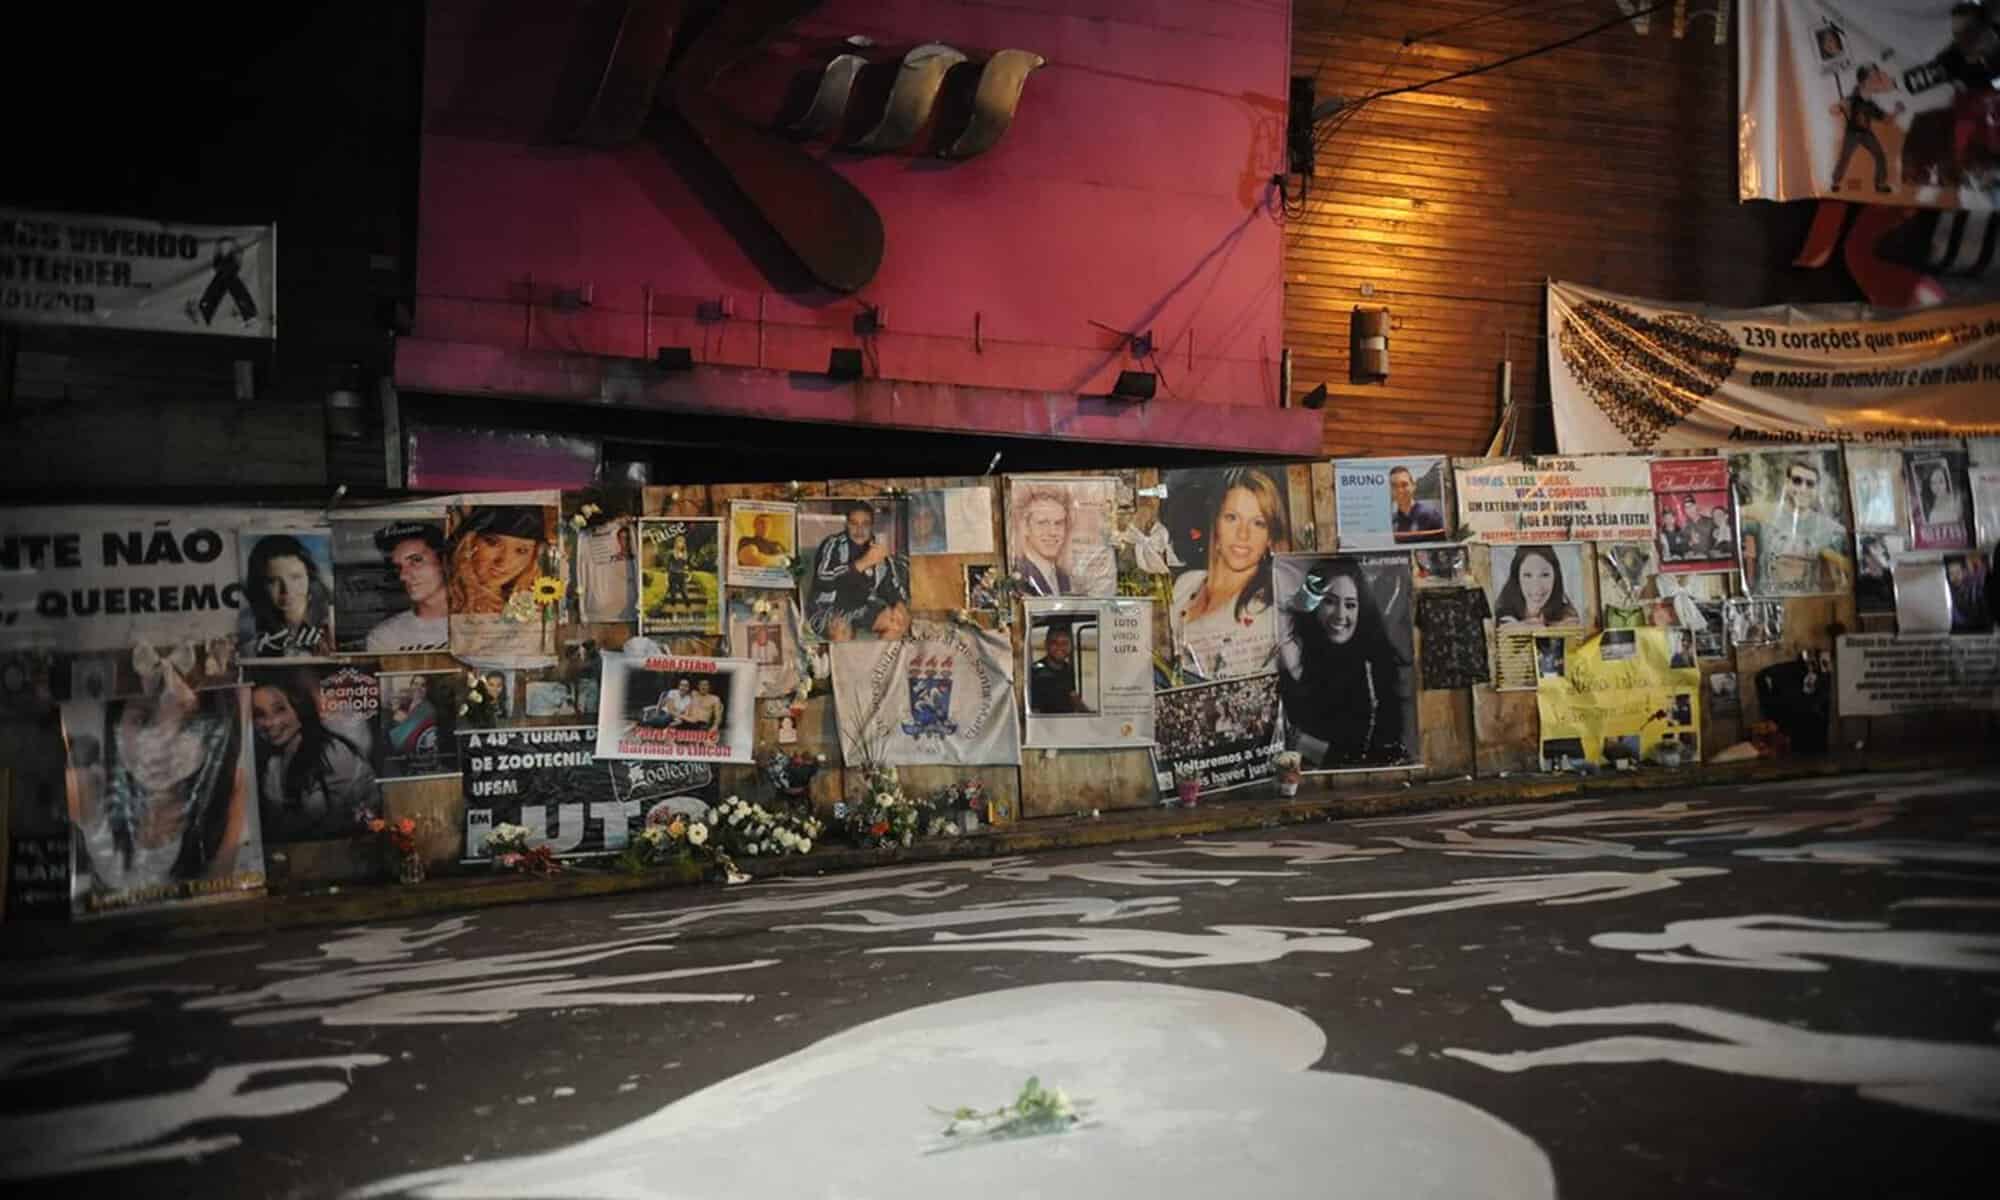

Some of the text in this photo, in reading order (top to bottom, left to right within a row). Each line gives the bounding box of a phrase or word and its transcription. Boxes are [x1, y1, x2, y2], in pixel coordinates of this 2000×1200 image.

[1743, 326, 1776, 347] 239
[1781, 326, 1861, 355] corações
[1866, 331, 1895, 352] que
[1751, 371, 1773, 386] em
[1775, 371, 1828, 387] nossas
[1728, 426, 1801, 442] Amamos
[1340, 475, 1385, 486] BRUNO
[102, 519, 224, 567] NÃO
[469, 733, 482, 749] A
[519, 730, 580, 745] TURMA
[471, 751, 594, 773] DE ZOOTECNIA
[1173, 752, 1243, 771] Voltaremos
[472, 778, 519, 797] UFSM
[470, 813, 489, 825] EM
